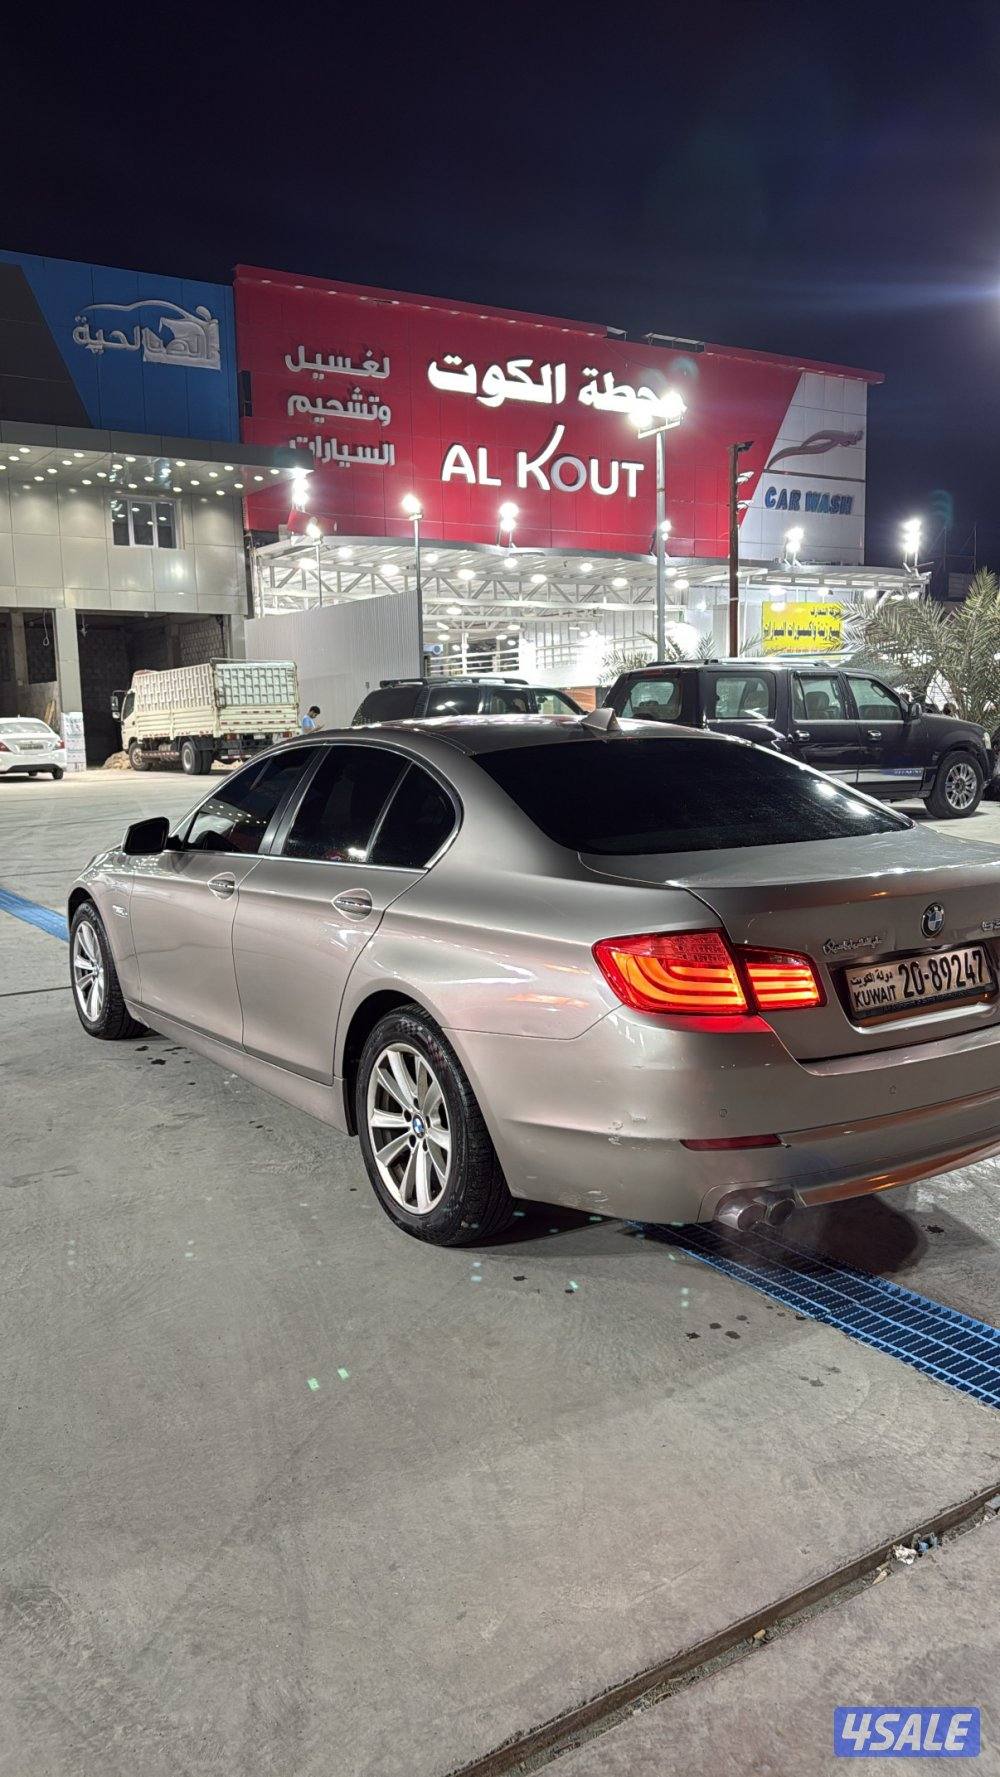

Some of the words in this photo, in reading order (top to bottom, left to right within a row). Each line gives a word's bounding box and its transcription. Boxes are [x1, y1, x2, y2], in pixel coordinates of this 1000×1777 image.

[284, 345, 390, 380] لغسيل
[427, 354, 567, 408] الكوت
[287, 386, 392, 427] وتشحيم
[441, 443, 502, 487] AL
[517, 424, 645, 498] KOUT
[764, 486, 802, 511] CAR
[804, 490, 854, 515] WASH
[850, 972, 876, 989] الكويت
[897, 949, 983, 999] 20-89247
[853, 984, 897, 1008] KUWAIT
